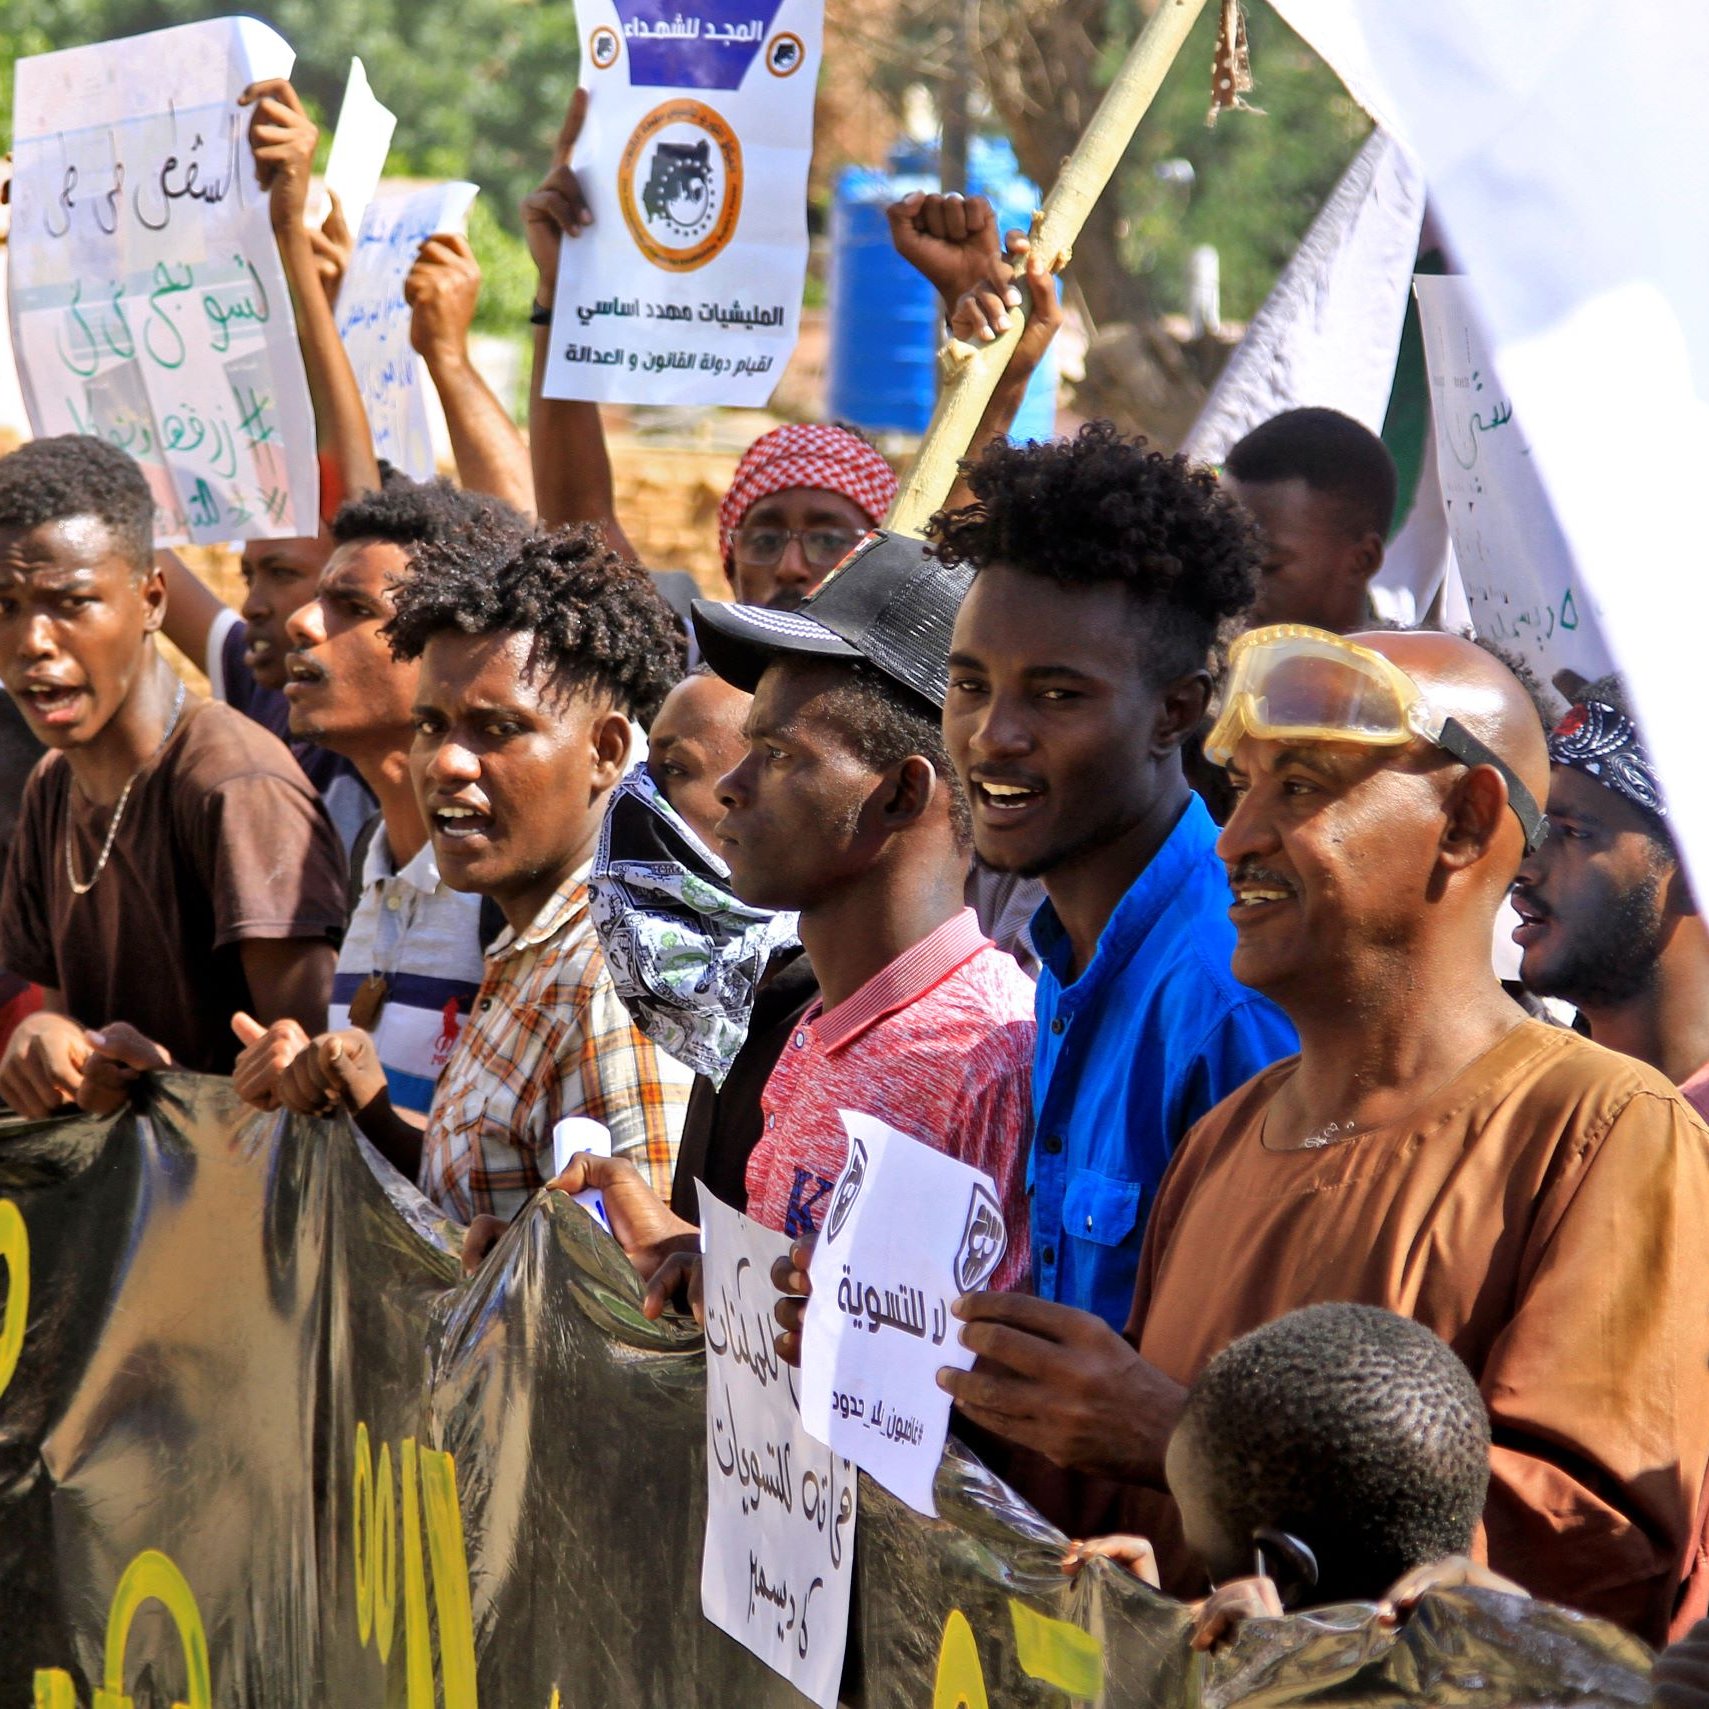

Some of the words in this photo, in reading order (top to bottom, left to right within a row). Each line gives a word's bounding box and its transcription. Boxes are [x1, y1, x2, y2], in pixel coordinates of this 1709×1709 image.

[624, 13, 700, 40] للشهداء
[704, 19, 764, 47] المجد
[646, 303, 693, 322] مهدد
[699, 300, 785, 330] المليشيات
[565, 344, 625, 366] العدالة
[628, 353, 639, 372] و
[642, 351, 697, 373] القانون
[700, 352, 730, 376] دولة
[732, 357, 773, 377] لقيام
[837, 1265, 926, 1339] للتسوية
[931, 1296, 948, 1347] لا
